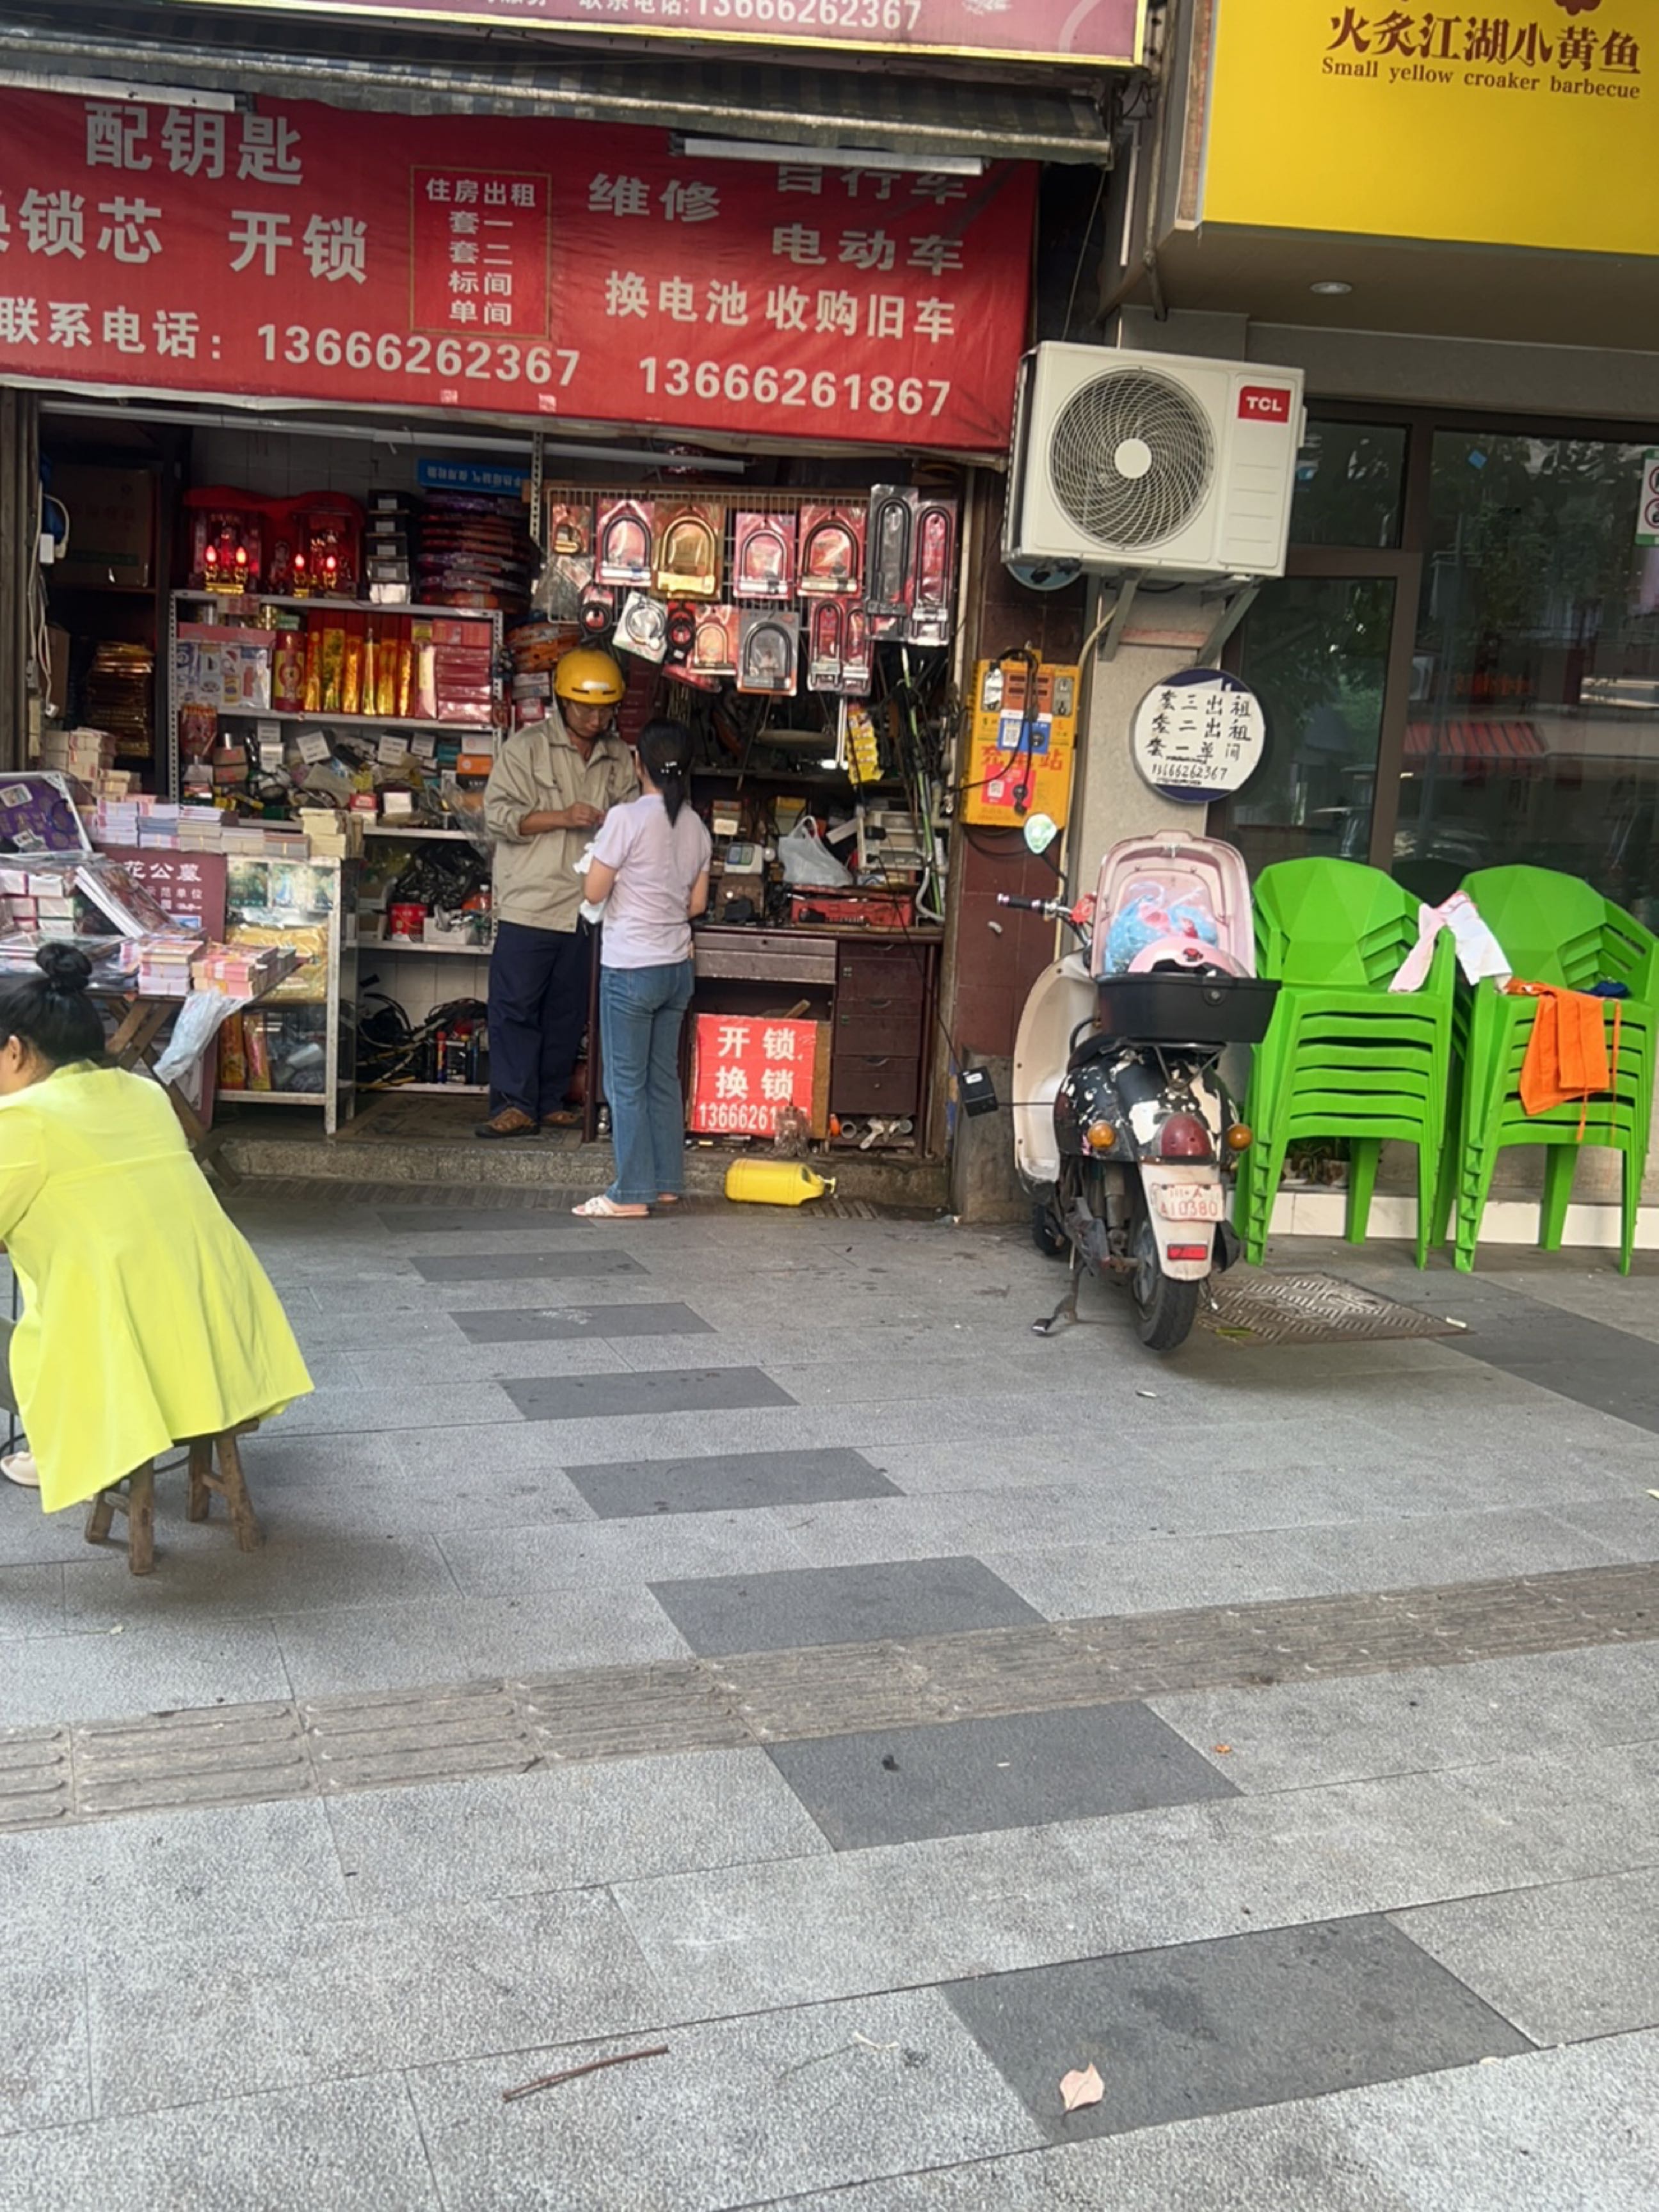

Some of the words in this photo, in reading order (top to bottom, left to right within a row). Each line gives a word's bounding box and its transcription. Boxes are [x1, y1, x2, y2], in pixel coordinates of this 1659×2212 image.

[1326, 6, 1641, 74] 火炙江湖小黄鱼
[1322, 57, 1379, 78] Small
[1389, 65, 1454, 84] yellow
[1464, 70, 1540, 92] croaker
[1550, 76, 1640, 99] barbecue
[84, 102, 304, 186] 配钥匙
[426, 178, 536, 208] 住房出租
[588, 172, 721, 222] 维修
[0, 188, 163, 264] 锁芯
[228, 210, 369, 284] 开锁
[449, 211, 513, 235] 套一
[449, 240, 513, 265] 套二
[773, 223, 965, 276] 电动车
[448, 270, 512, 296] 标间
[449, 299, 512, 326] 单间
[605, 271, 749, 326] 换电池
[765, 285, 956, 344] 收购旧车
[257, 325, 580, 387] 13666262367
[639, 357, 951, 417] 13666261867
[1246, 396, 1282, 412] TCL
[716, 1065, 794, 1102] 换锁
[700, 1102, 808, 1131] 13666261
